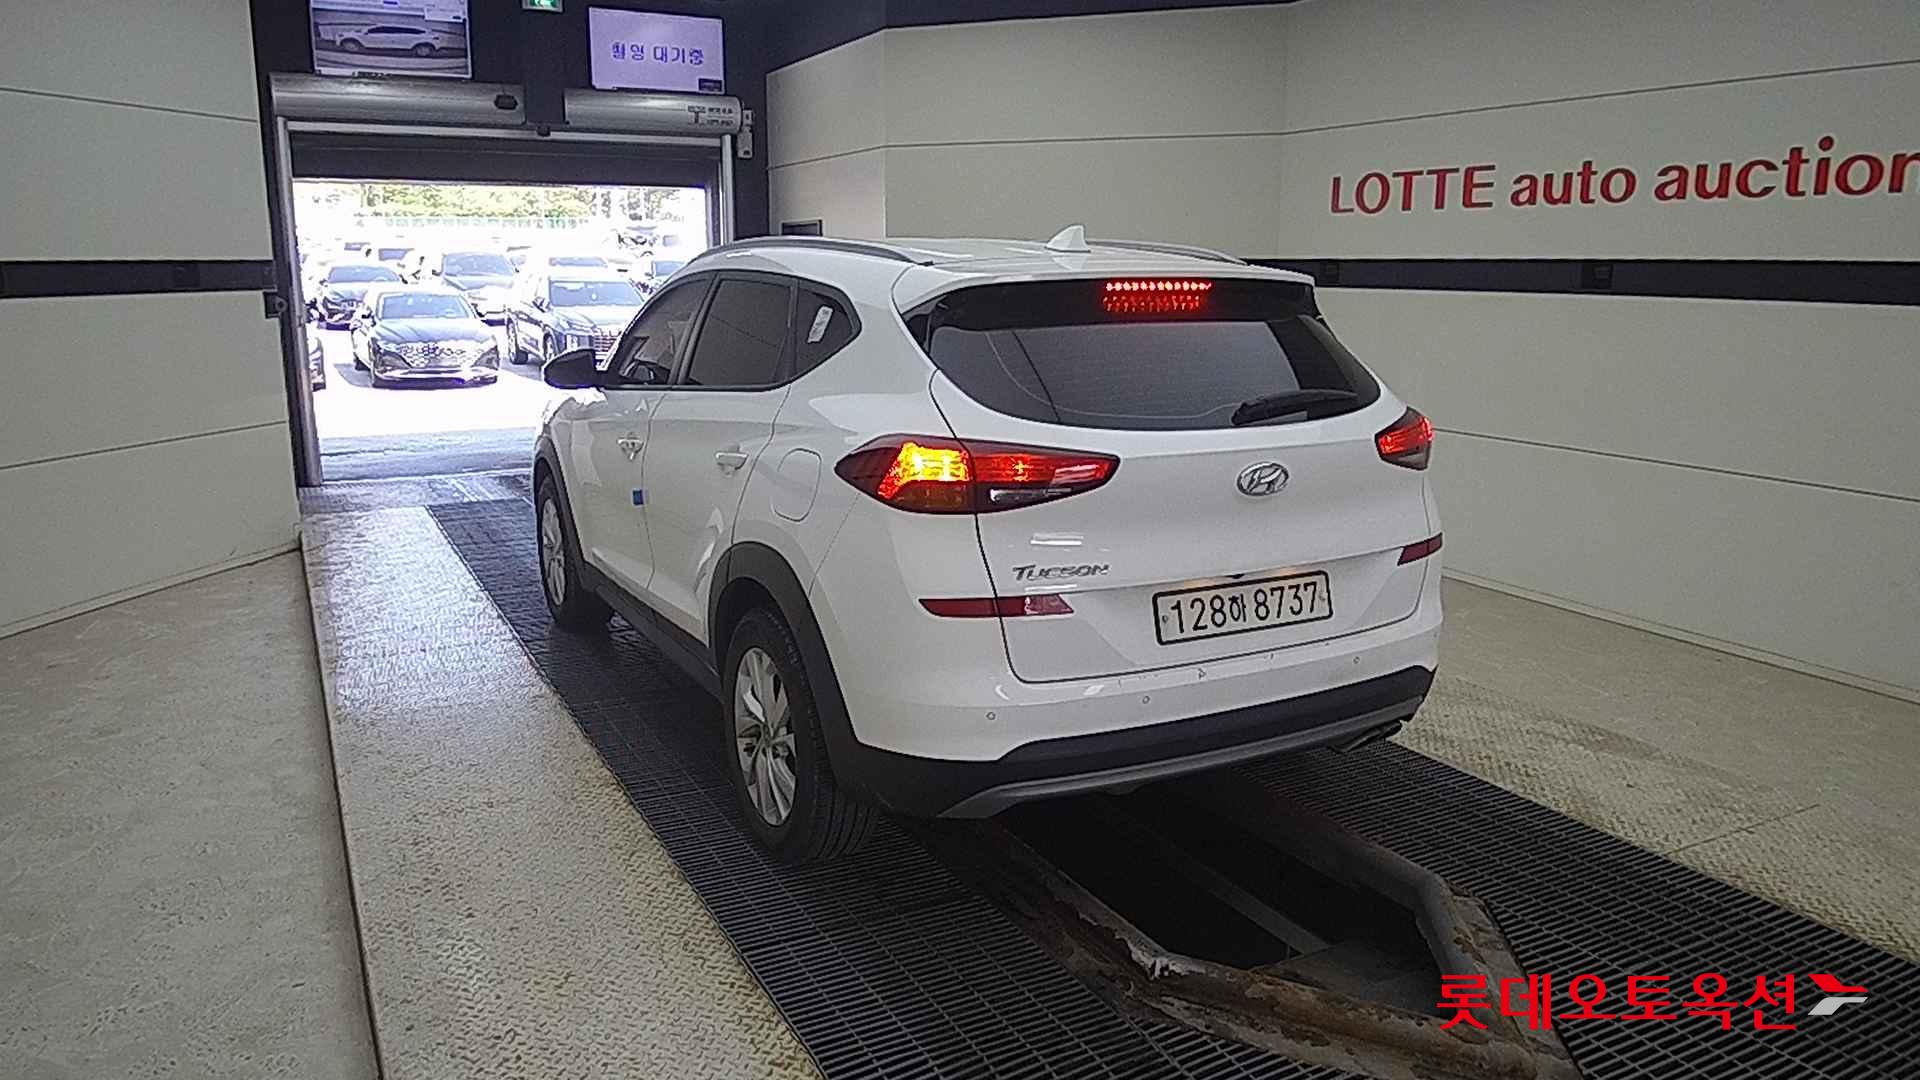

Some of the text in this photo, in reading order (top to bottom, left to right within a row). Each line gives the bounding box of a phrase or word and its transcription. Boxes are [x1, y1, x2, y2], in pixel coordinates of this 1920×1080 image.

[653, 45, 704, 66] 대기중
[1330, 163, 1497, 215] LOTTE
[1509, 159, 1638, 207] auto
[1012, 564, 1110, 581] TUCSON
